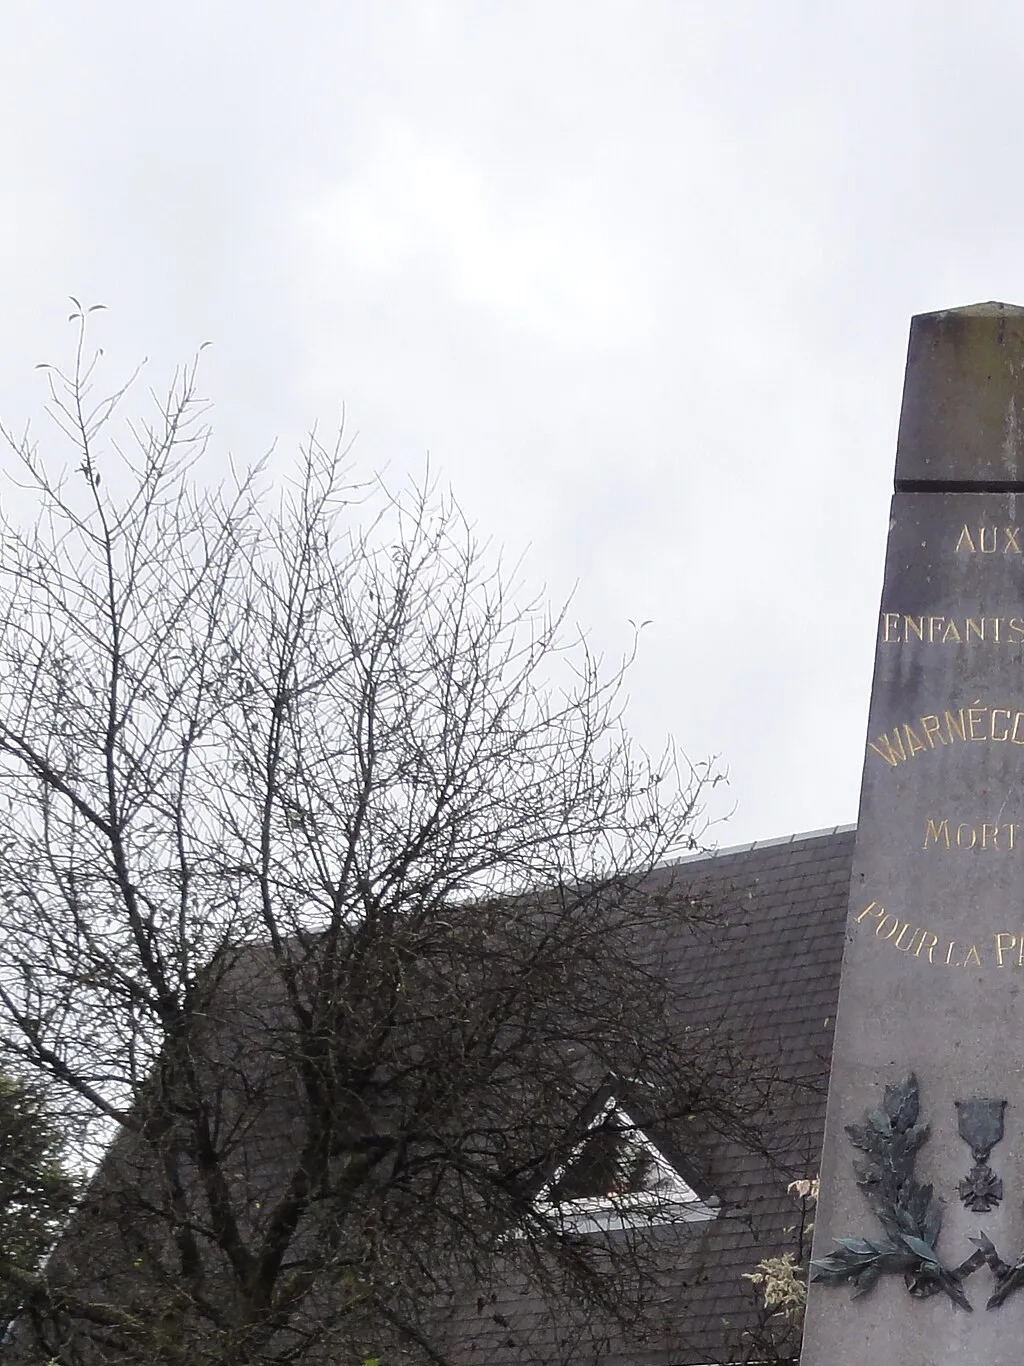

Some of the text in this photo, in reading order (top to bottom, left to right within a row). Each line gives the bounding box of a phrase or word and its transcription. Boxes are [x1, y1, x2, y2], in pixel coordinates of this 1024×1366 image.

[955, 524, 1022, 554] AUX
[853, 900, 938, 964] POUR
[945, 941, 982, 968] LA
